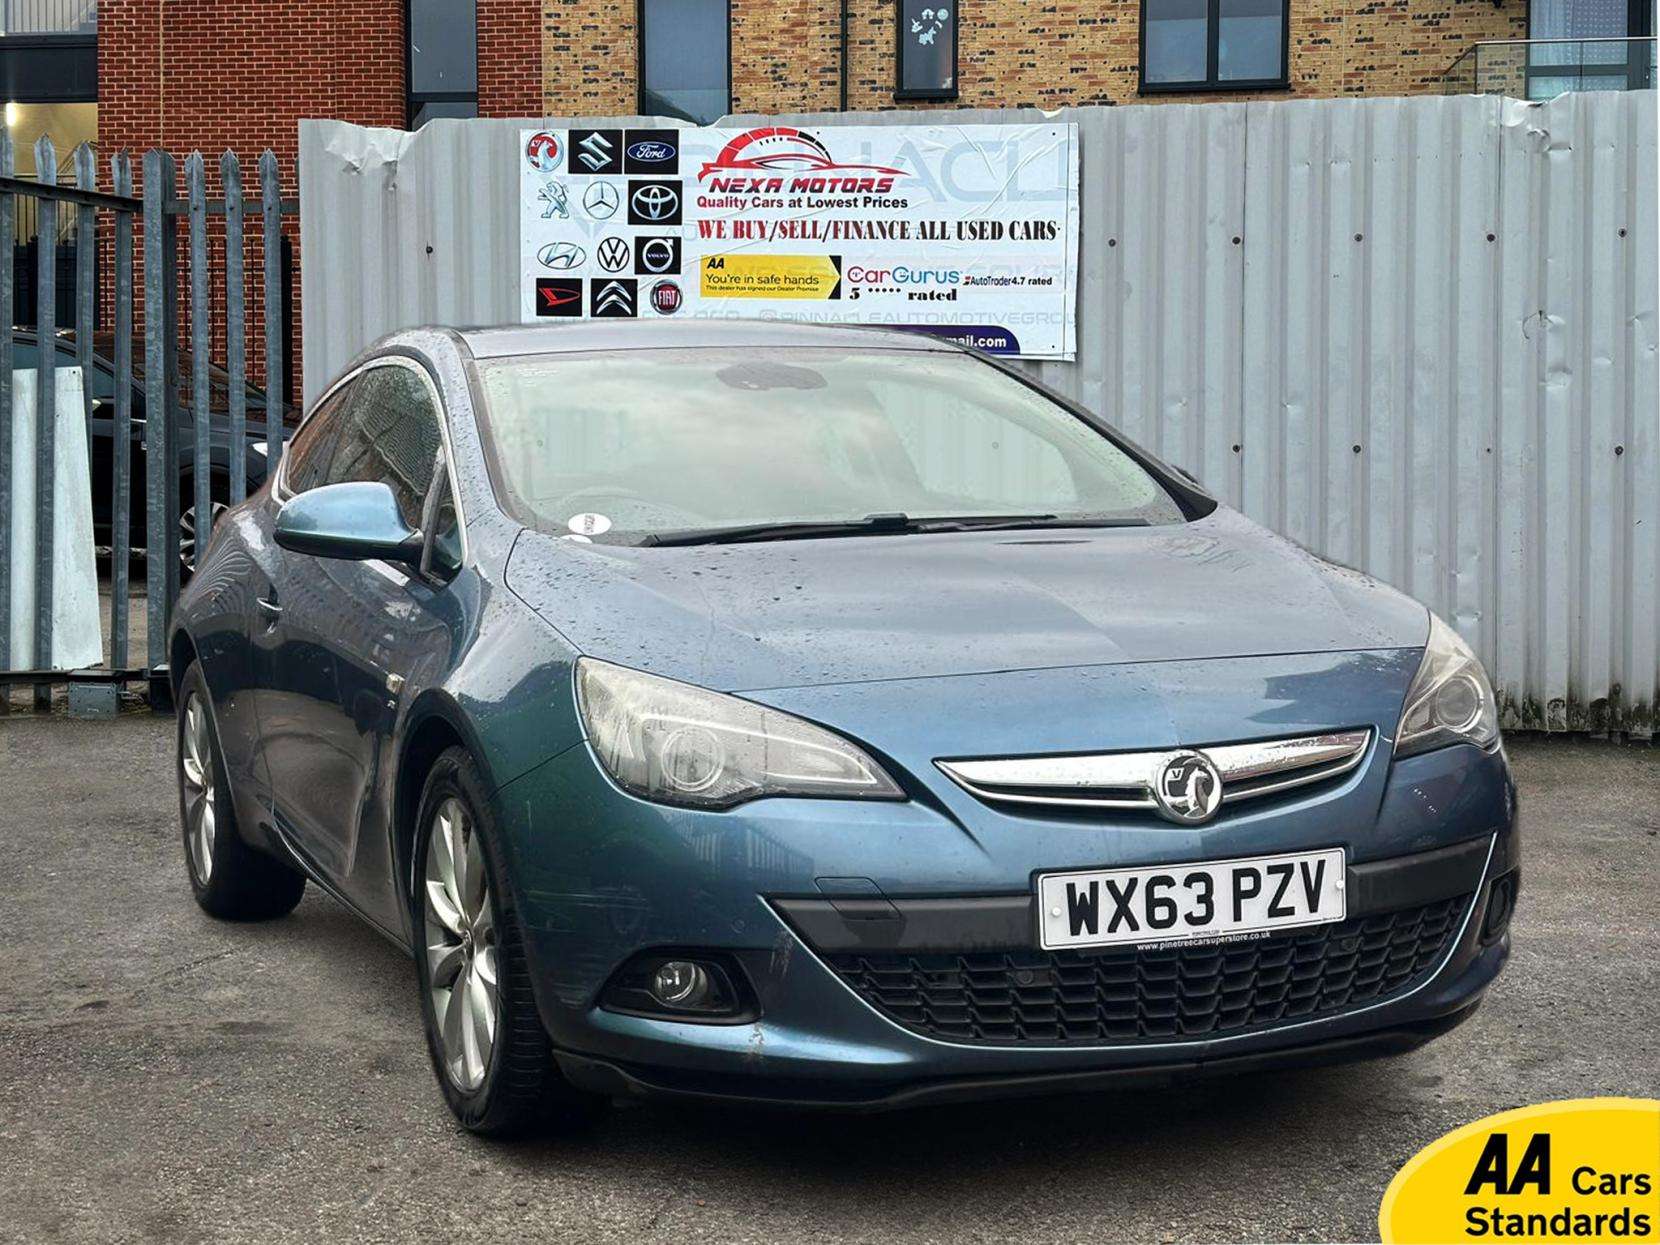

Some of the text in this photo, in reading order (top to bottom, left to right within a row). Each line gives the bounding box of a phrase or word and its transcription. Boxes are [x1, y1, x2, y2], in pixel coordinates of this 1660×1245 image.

[637, 144, 666, 158] Ford
[709, 178, 894, 193] NEXA MOTORS
[697, 196, 908, 210] Quality Cars at Lowest Prices
[697, 220, 726, 240] WE
[916, 220, 950, 240] ALL
[957, 220, 1004, 240] USED
[707, 258, 725, 269] AA
[706, 273, 819, 285] You're in safe hands
[847, 266, 960, 284] CarGurus
[970, 276, 1053, 286] AutoTrader 4.7 rated
[658, 290, 677, 305] FIAT
[849, 287, 957, 301] 5 rated
[1066, 859, 1326, 936] WX63 PZV
[1137, 931, 1271, 951] www.pinetreecarsuperstore.co.uk
